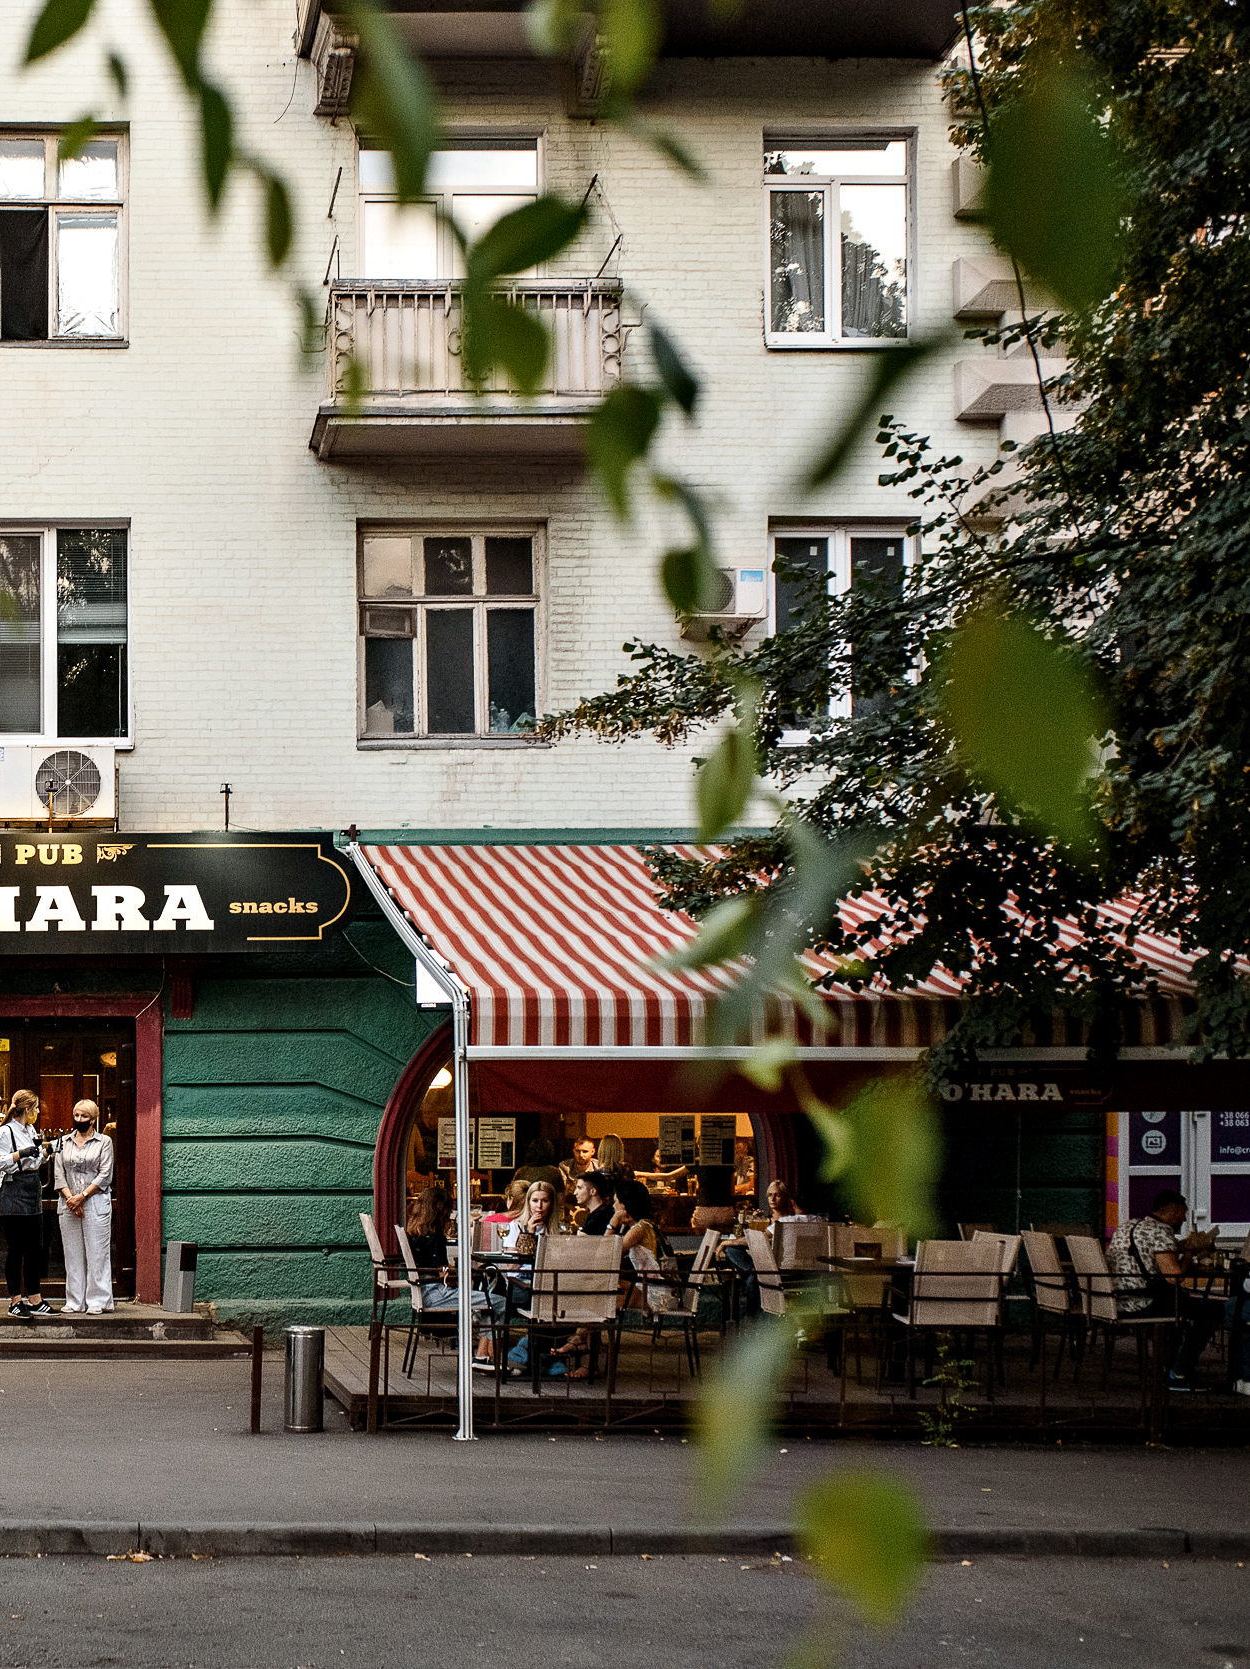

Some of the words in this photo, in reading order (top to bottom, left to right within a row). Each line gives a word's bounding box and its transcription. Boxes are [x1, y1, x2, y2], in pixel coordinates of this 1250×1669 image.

[14, 843, 84, 865] PUB
[229, 897, 319, 915] snacks
[941, 1082, 1064, 1102] O'HARA
[1219, 1145, 1250, 1155] info@cr
